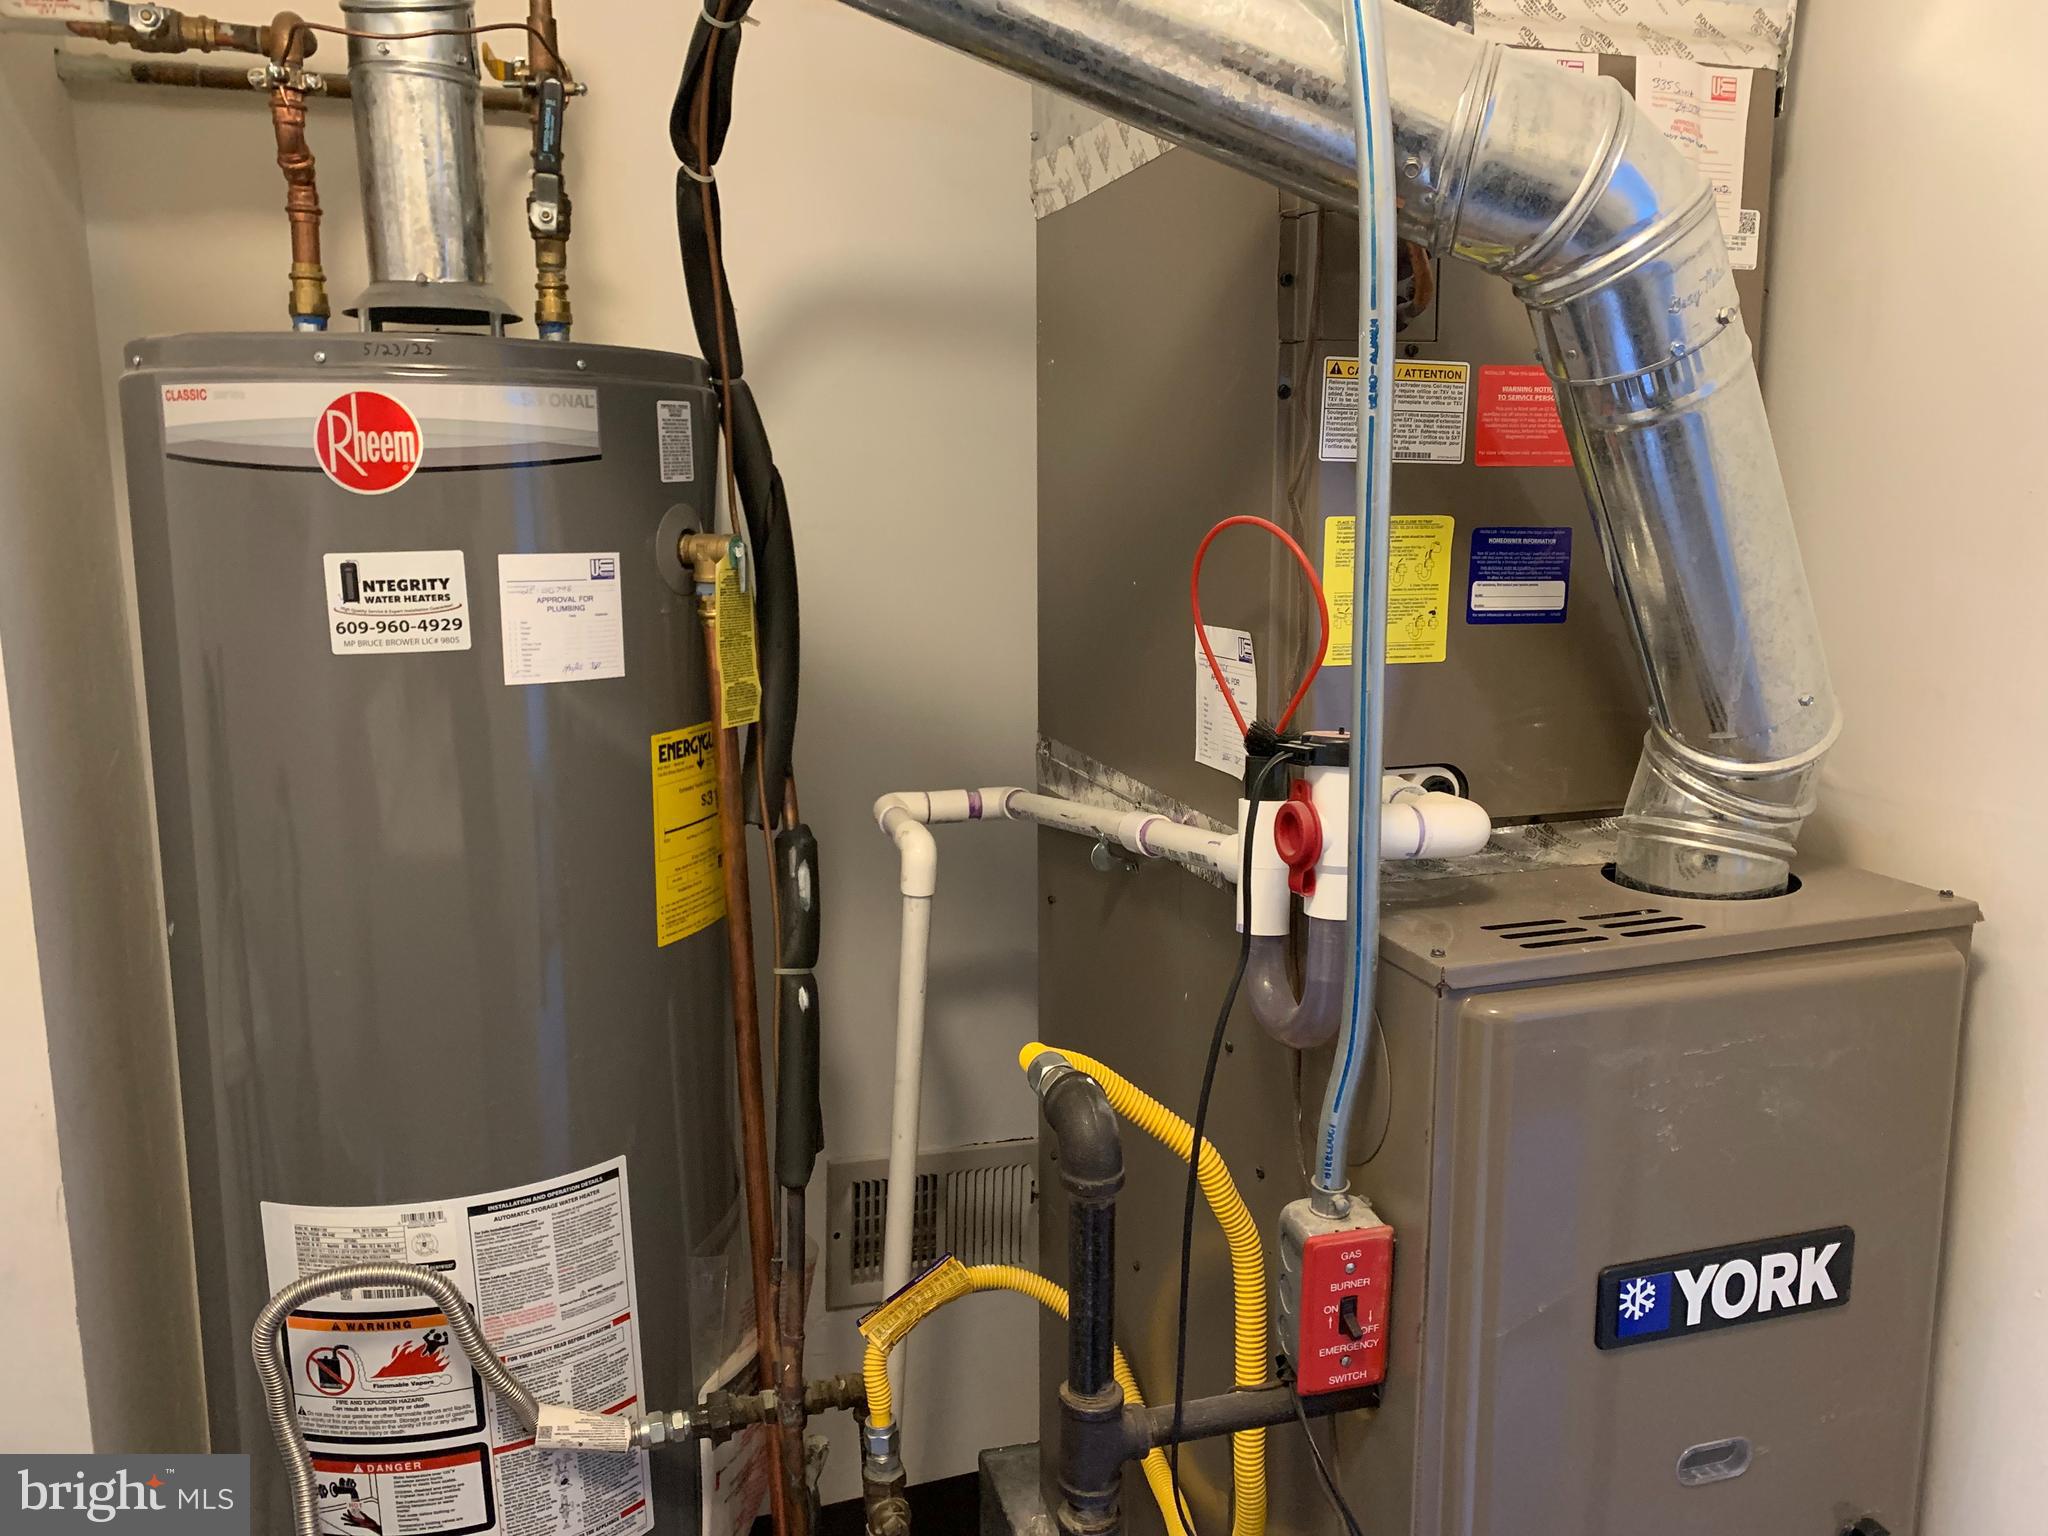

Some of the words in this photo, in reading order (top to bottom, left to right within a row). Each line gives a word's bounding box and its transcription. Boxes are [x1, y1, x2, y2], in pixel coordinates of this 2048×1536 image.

[362, 343, 432, 355] 5/23/25
[1404, 368, 1462, 379] ATTENTION
[165, 389, 207, 401] CLASSIC
[326, 393, 416, 477] Rheem
[365, 595, 401, 604] WATER
[404, 594, 451, 603] HEATERS
[537, 596, 576, 604] APPROVAL
[547, 605, 586, 613] PLUMBING
[336, 618, 463, 635] 609-960-4929
[358, 639, 384, 647] BRUCE
[386, 638, 420, 646] BROWER
[488, 1200, 531, 1212] INSTALLATION
[532, 1193, 547, 1202] AND
[547, 1184, 580, 1198] OPERATION
[581, 1177, 603, 1188] DETAILS
[494, 1210, 530, 1222] AUTOMATIC
[531, 1203, 558, 1214] STORAGE
[559, 1196, 579, 1207] WATER
[579, 1189, 600, 1201] HEATER
[1341, 1250, 1362, 1261] GAS
[1330, 1278, 1371, 1292] BURNER
[1674, 1242, 1842, 1326] YORK
[345, 1320, 412, 1331] WARNING
[1324, 1305, 1339, 1315] ON
[1362, 1324, 1380, 1335] OFF
[1319, 1339, 1380, 1358] EMERGENCY
[1329, 1370, 1367, 1385] SWITCH
[373, 1381, 409, 1389] Flammable
[411, 1380, 434, 1388] Vapors
[367, 1461, 422, 1473] DANGER
